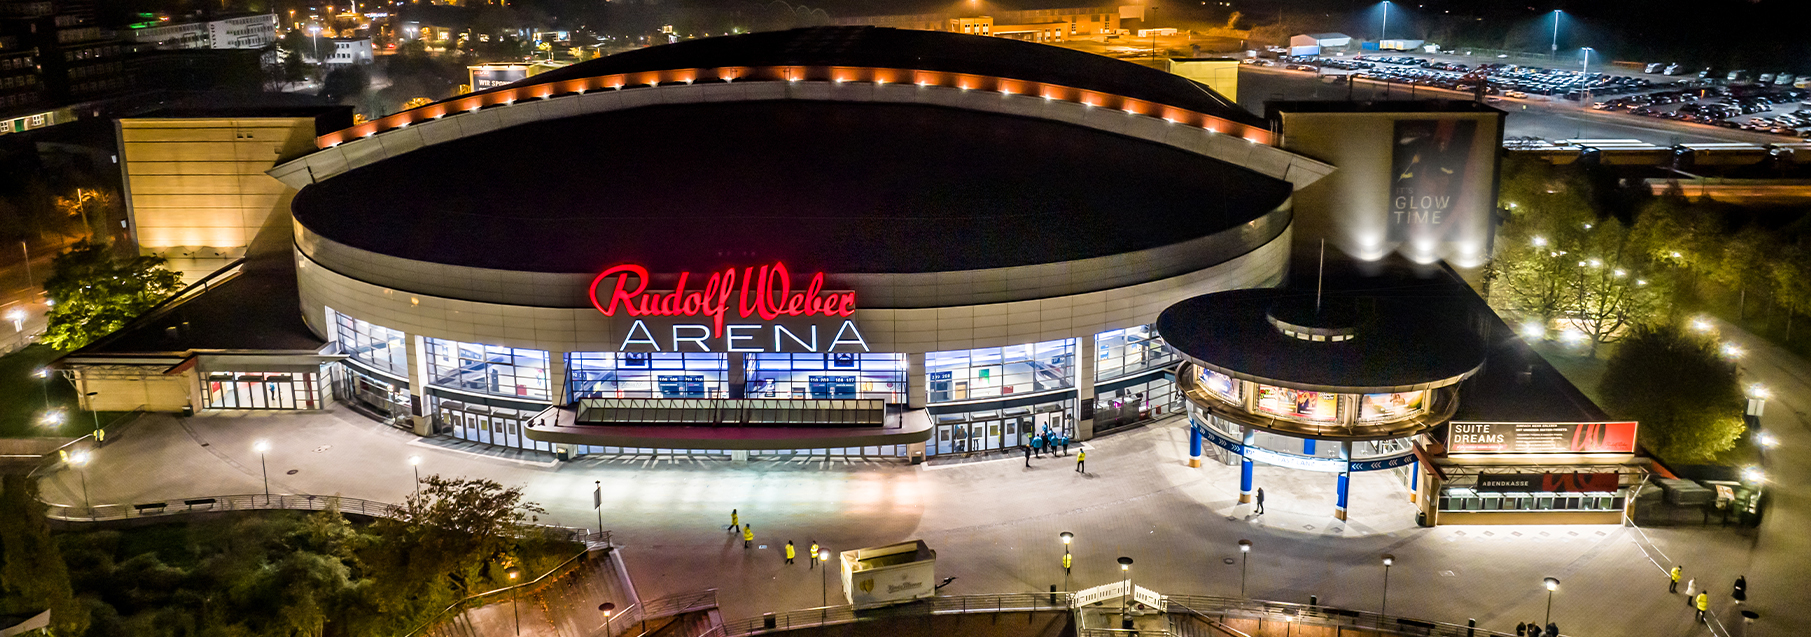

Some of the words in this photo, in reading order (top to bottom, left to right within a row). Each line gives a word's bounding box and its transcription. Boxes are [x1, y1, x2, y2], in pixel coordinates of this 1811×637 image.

[1395, 196, 1450, 210] GLOW
[1394, 211, 1442, 224] TIME
[589, 263, 736, 339] Rudolf
[738, 261, 856, 321] Weber
[619, 320, 871, 353] ARENA
[1455, 424, 1491, 434] SUITE
[1454, 434, 1505, 443] DREAMS
